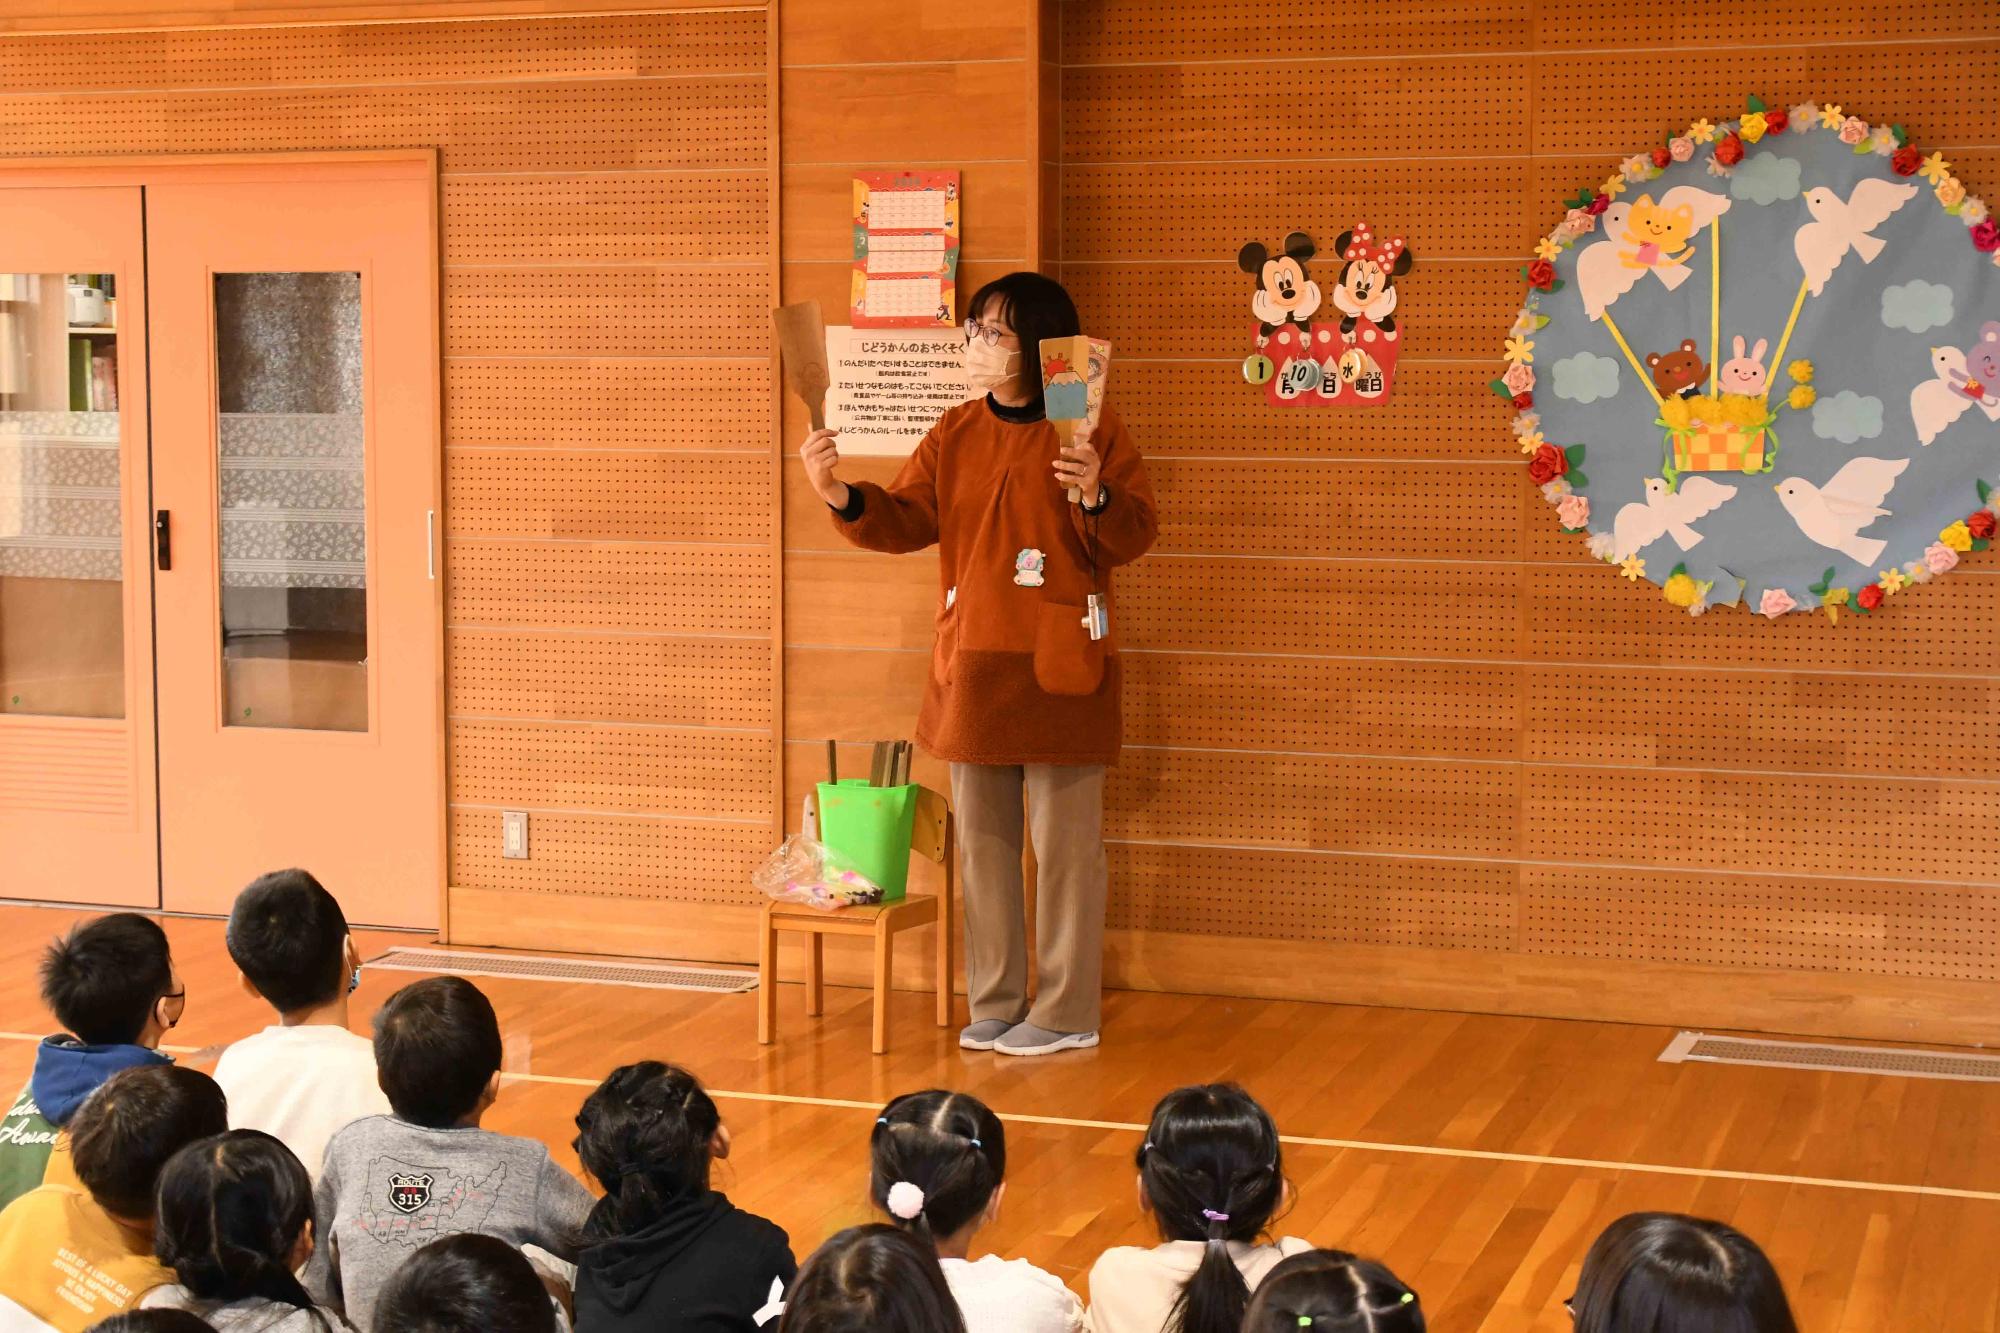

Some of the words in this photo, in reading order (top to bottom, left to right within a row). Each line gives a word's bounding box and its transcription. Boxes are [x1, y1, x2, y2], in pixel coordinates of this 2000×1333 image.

[861, 342, 965, 354] じどうかんのおやくそく
[1258, 362, 1264, 379] 1
[1290, 365, 1307, 382] 10
[1342, 362, 1354, 378] 水
[1281, 379, 1295, 394] 月
[1322, 379, 1336, 394] 日
[1355, 378, 1383, 392] 曜日
[398, 1193, 422, 1205] 315
